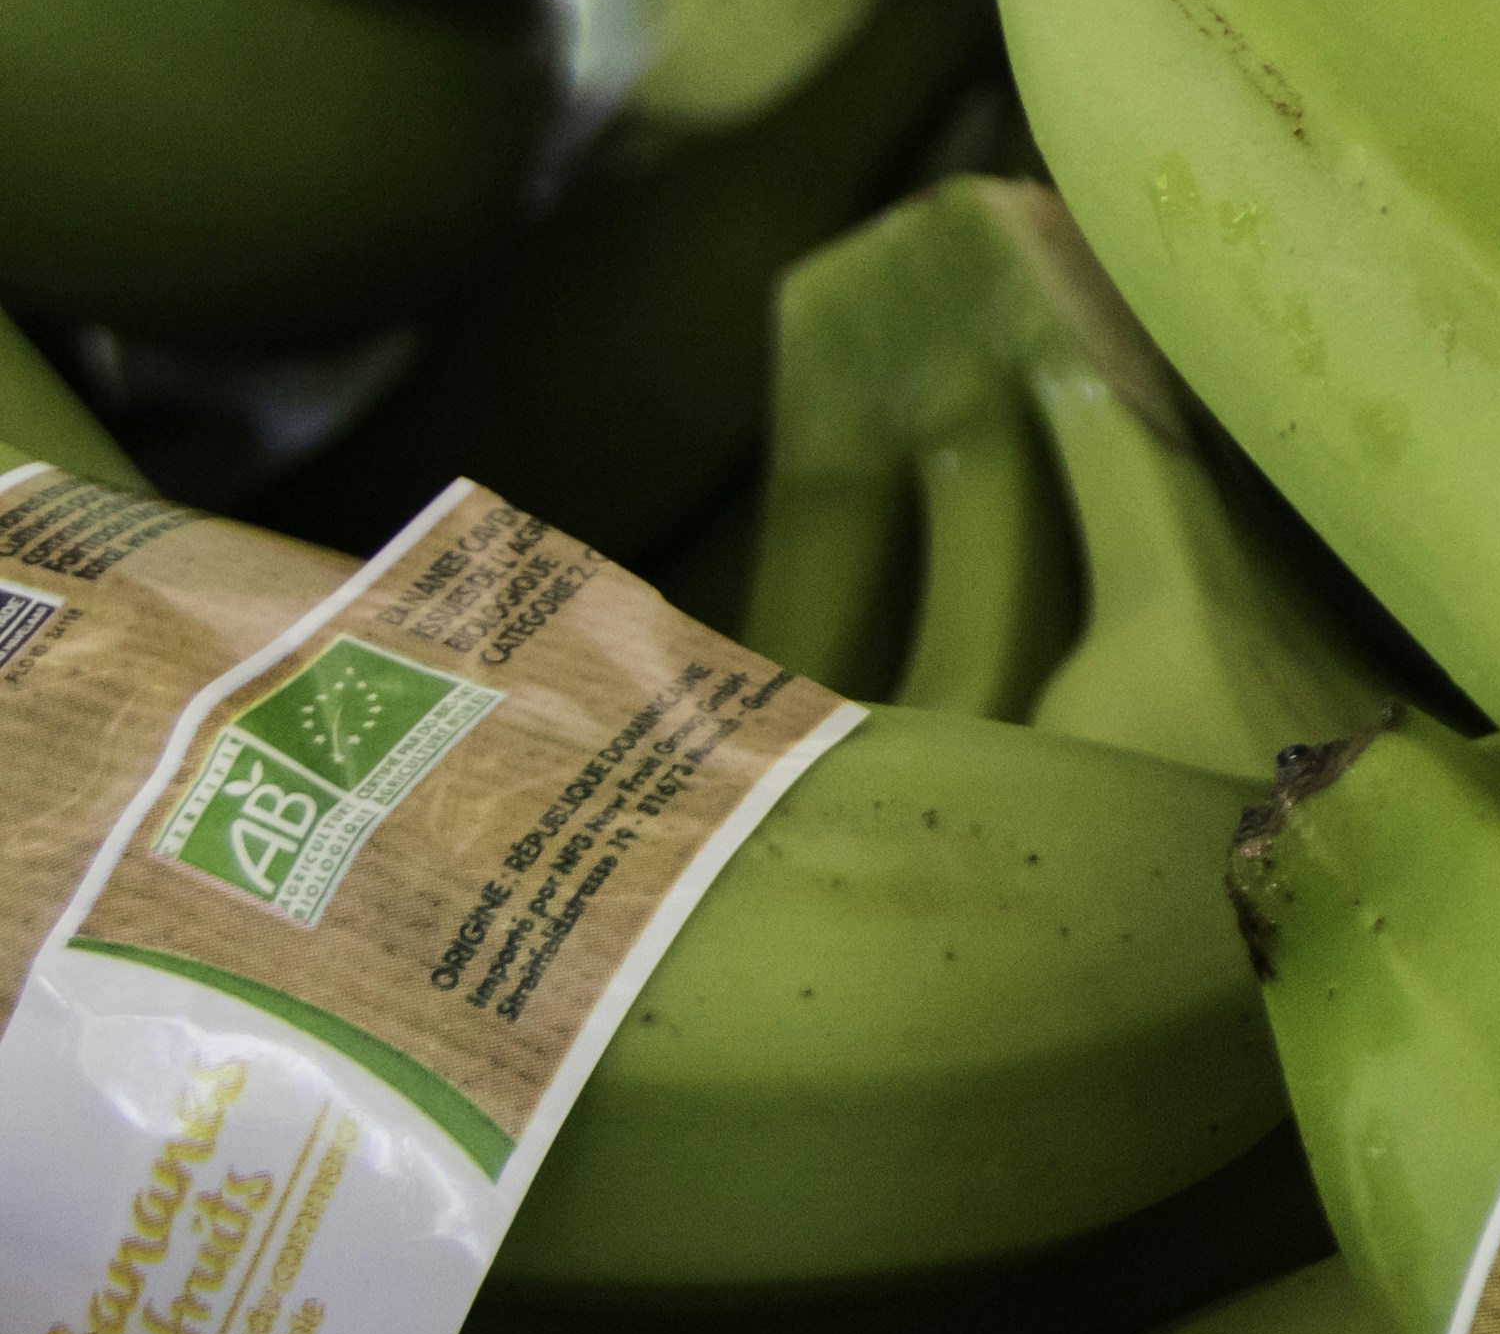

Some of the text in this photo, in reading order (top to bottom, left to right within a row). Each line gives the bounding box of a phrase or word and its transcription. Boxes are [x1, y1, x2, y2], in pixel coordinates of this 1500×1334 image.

[442, 554, 562, 654] BIOLOGIQUE
[230, 784, 318, 895] AB
[277, 800, 354, 908] AGRICULTURE
[291, 807, 372, 919] BIOLOGIQUE
[528, 875, 562, 918] par
[550, 832, 594, 876] NFG
[617, 756, 663, 794] Fruit
[431, 879, 513, 991] ORIGINE
